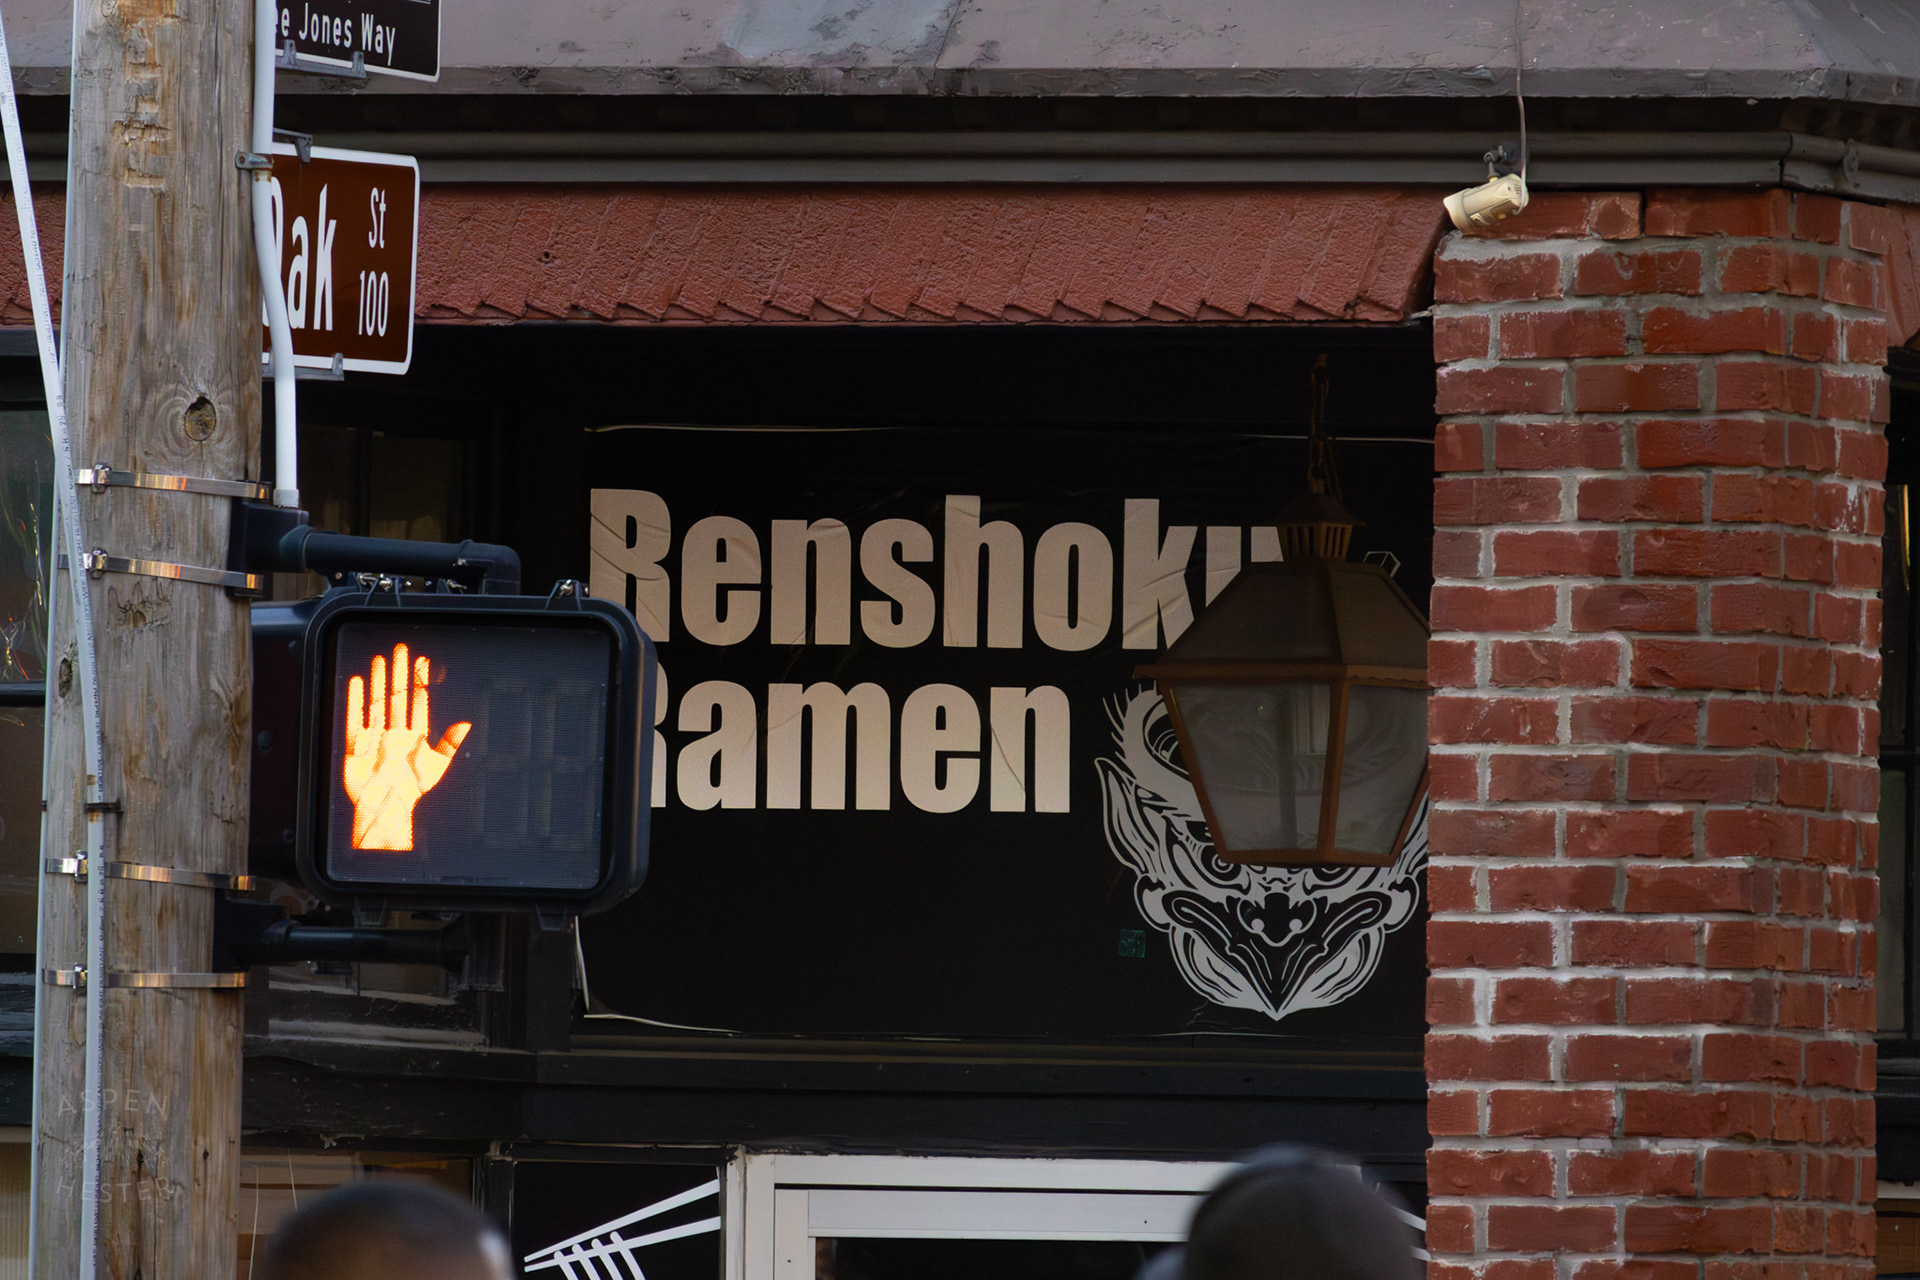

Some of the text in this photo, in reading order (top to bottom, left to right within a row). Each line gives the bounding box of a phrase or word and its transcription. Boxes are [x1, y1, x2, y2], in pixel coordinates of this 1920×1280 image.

[275, 2, 397, 67] e Jones Way
[368, 187, 387, 249] St
[358, 270, 389, 338] 100
